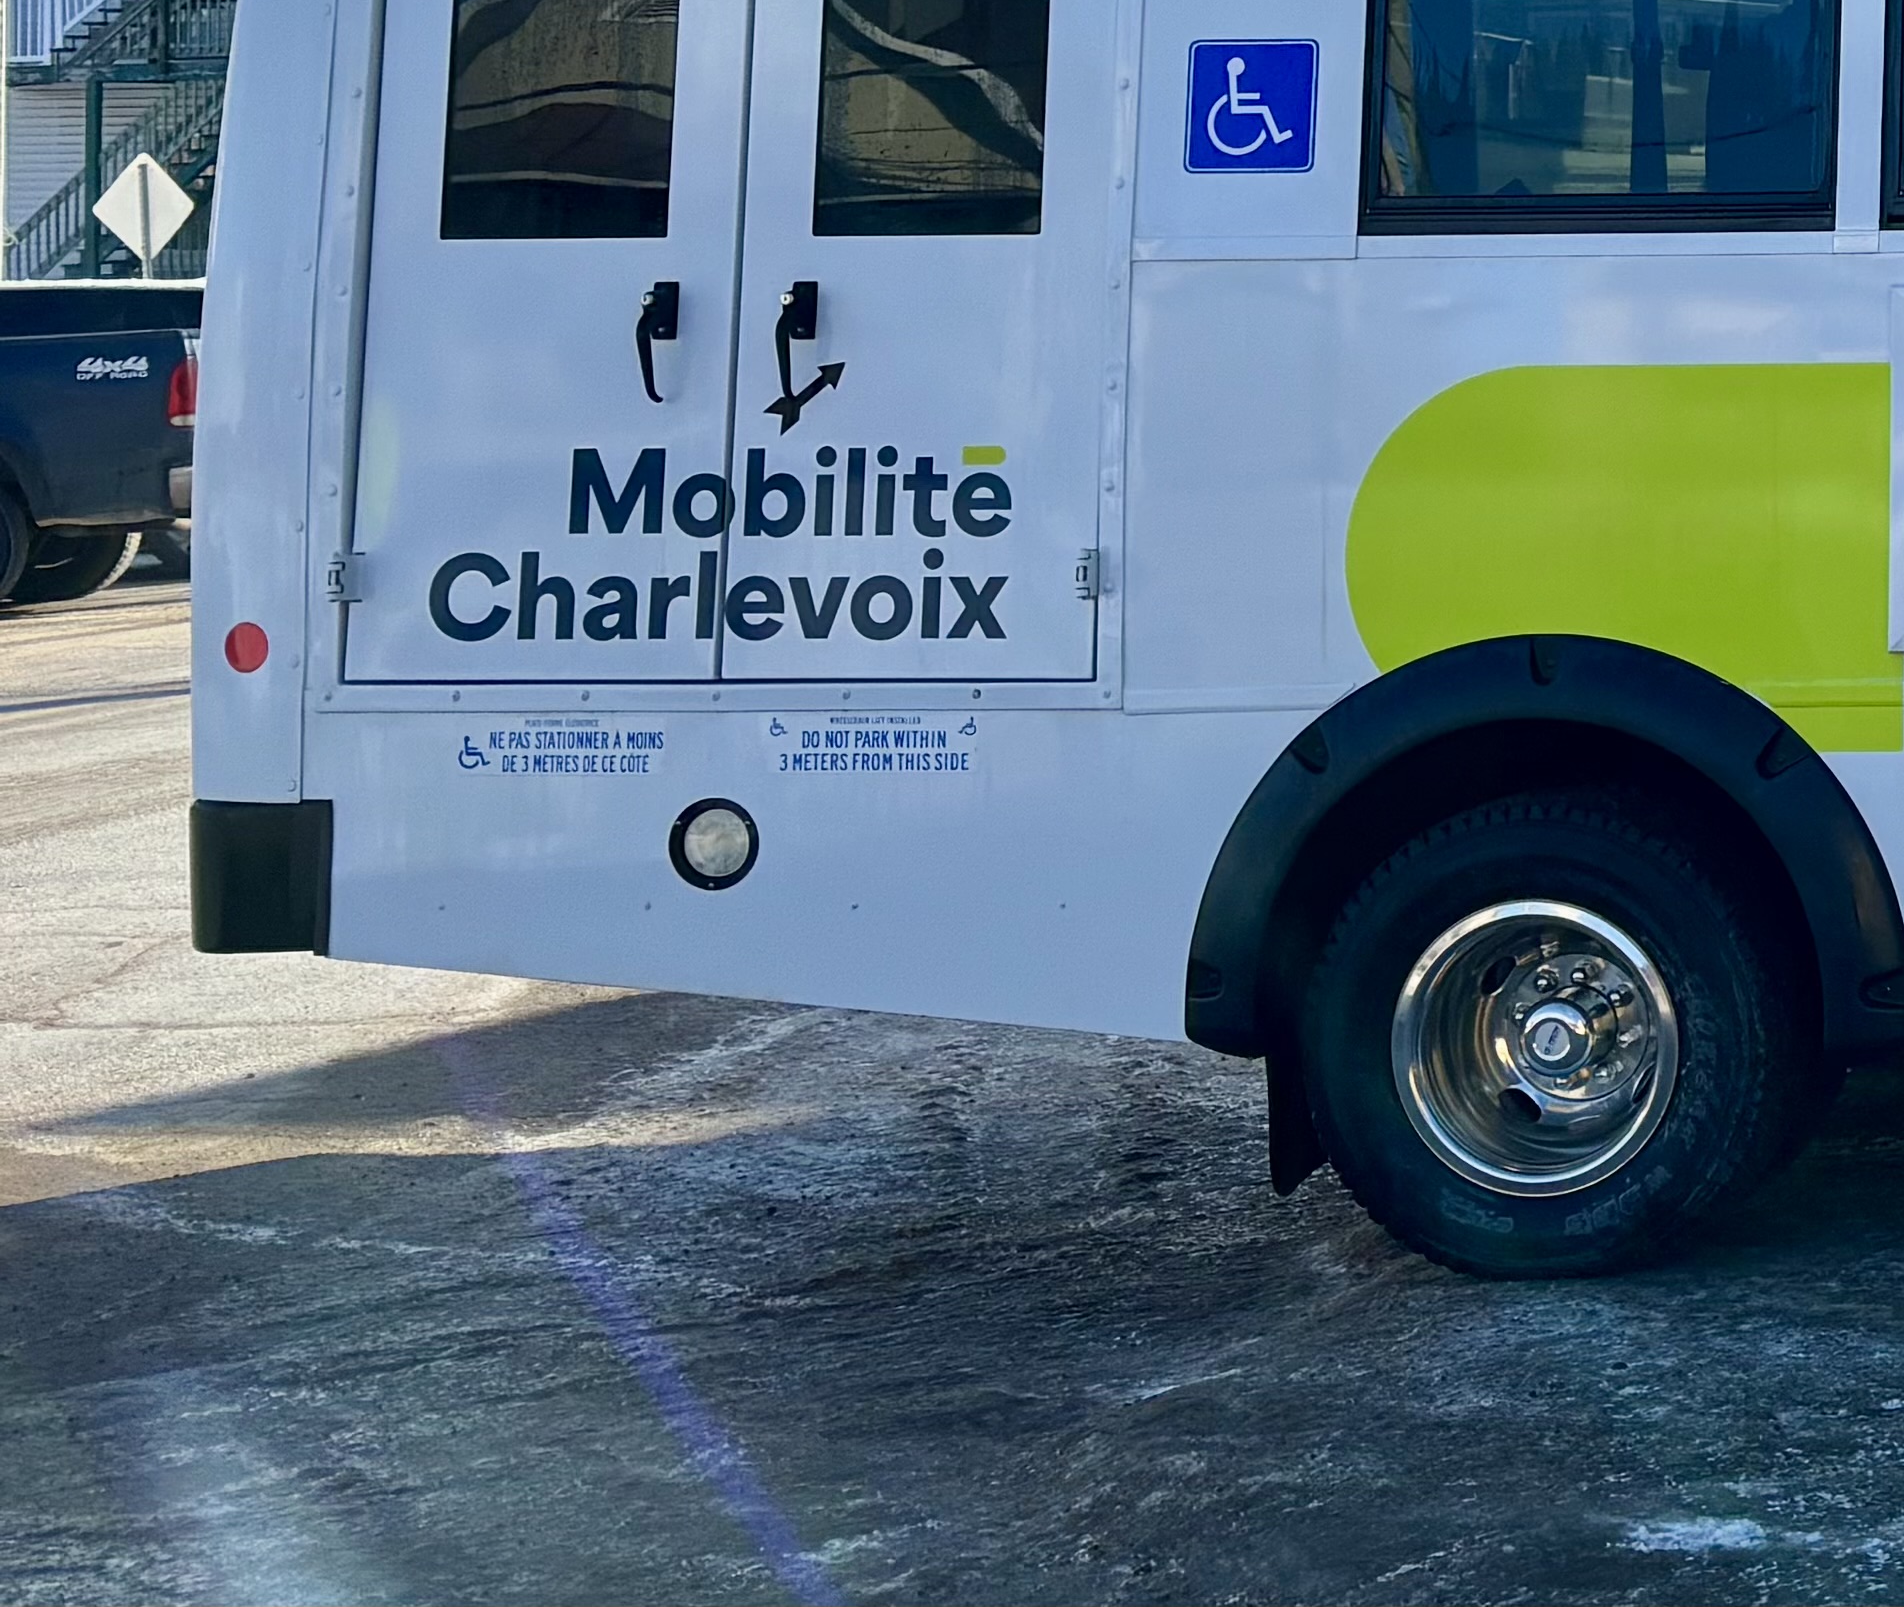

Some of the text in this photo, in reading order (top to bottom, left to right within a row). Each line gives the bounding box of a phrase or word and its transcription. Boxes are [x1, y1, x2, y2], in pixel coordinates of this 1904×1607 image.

[428, 548, 1009, 642] Charlevoix
[489, 731, 505, 749] NE
[509, 731, 531, 749] PAS
[535, 731, 609, 749] STATIONNER
[626, 731, 664, 749] MOINS
[801, 730, 947, 749] DO NOT PARK WITHIN
[502, 754, 517, 773] DE
[521, 754, 529, 773] 3
[582, 754, 598, 773] DE
[602, 754, 616, 773] CE
[779, 753, 970, 771] 3 METERS FROM THIS SIDE
